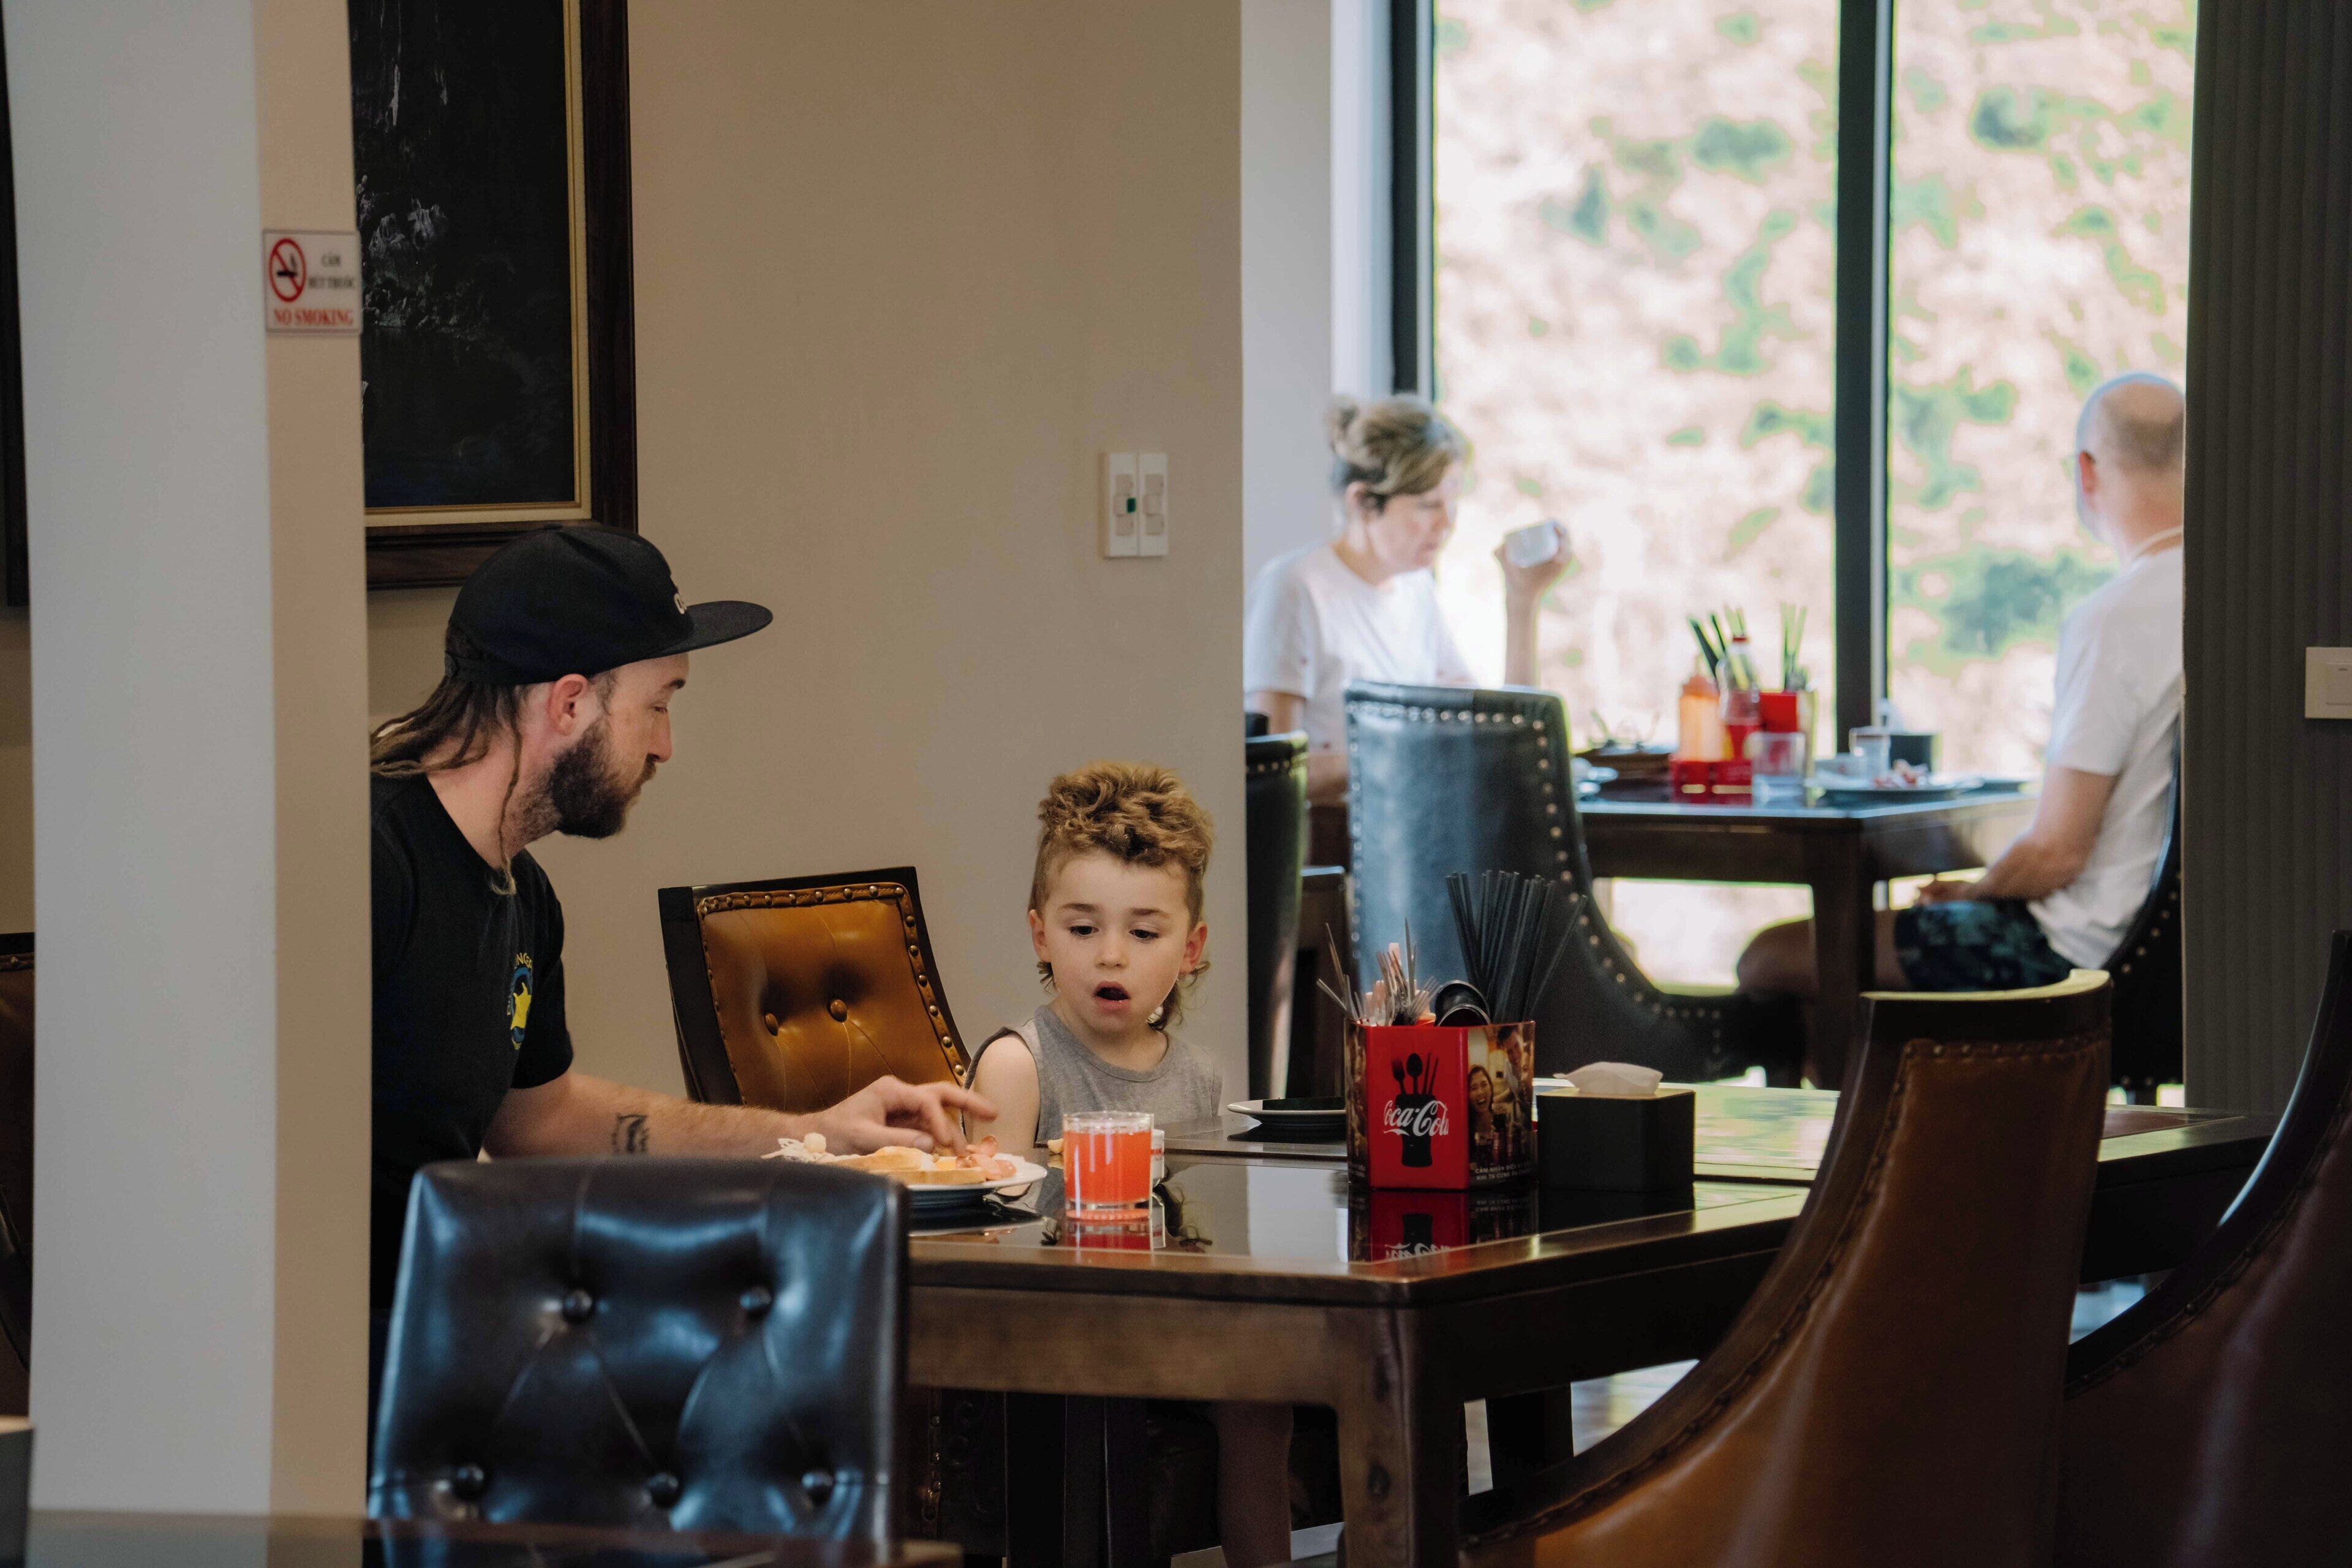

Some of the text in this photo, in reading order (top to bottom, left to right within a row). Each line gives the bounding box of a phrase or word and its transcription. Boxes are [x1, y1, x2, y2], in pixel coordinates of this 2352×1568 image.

[274, 308, 354, 326] NO SMOKING
[1383, 1100, 1449, 1137] Coca-Cola
